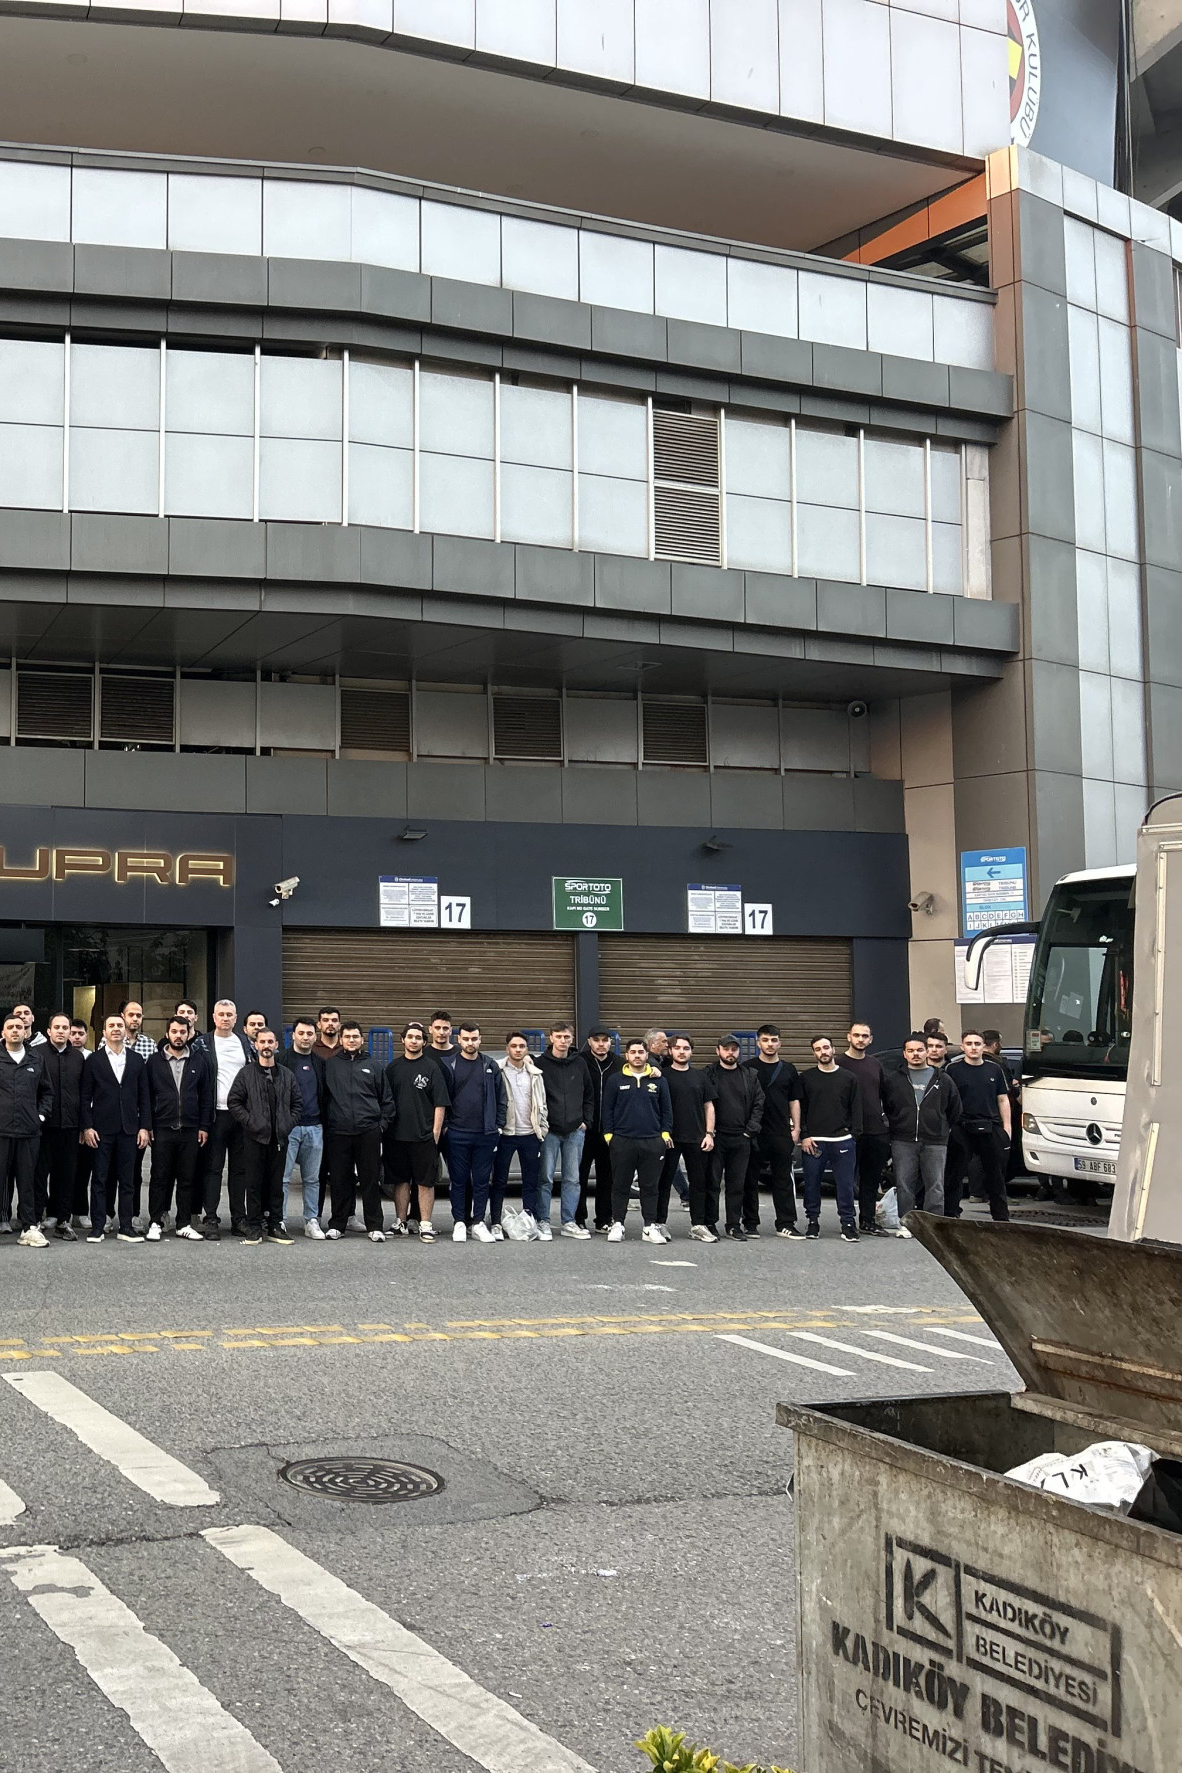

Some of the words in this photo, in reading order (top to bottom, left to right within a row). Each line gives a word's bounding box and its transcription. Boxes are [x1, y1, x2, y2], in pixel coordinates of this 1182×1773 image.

[1020, 33, 1038, 139] KULÜBÜ
[445, 902, 466, 922] 17
[570, 895, 606, 904] TRİBÜNÜ
[584, 915, 594, 924] 17
[748, 909, 768, 929] 17
[904, 1558, 952, 1639] K
[974, 1590, 1070, 1645] KADIKÖY
[831, 1620, 970, 1721] KADIKÖY
[980, 1693, 1144, 1773] BELEDİ
[975, 1634, 1099, 1707] BELEDİYESİ
[855, 1688, 969, 1767] ÇEVREMİZİ
